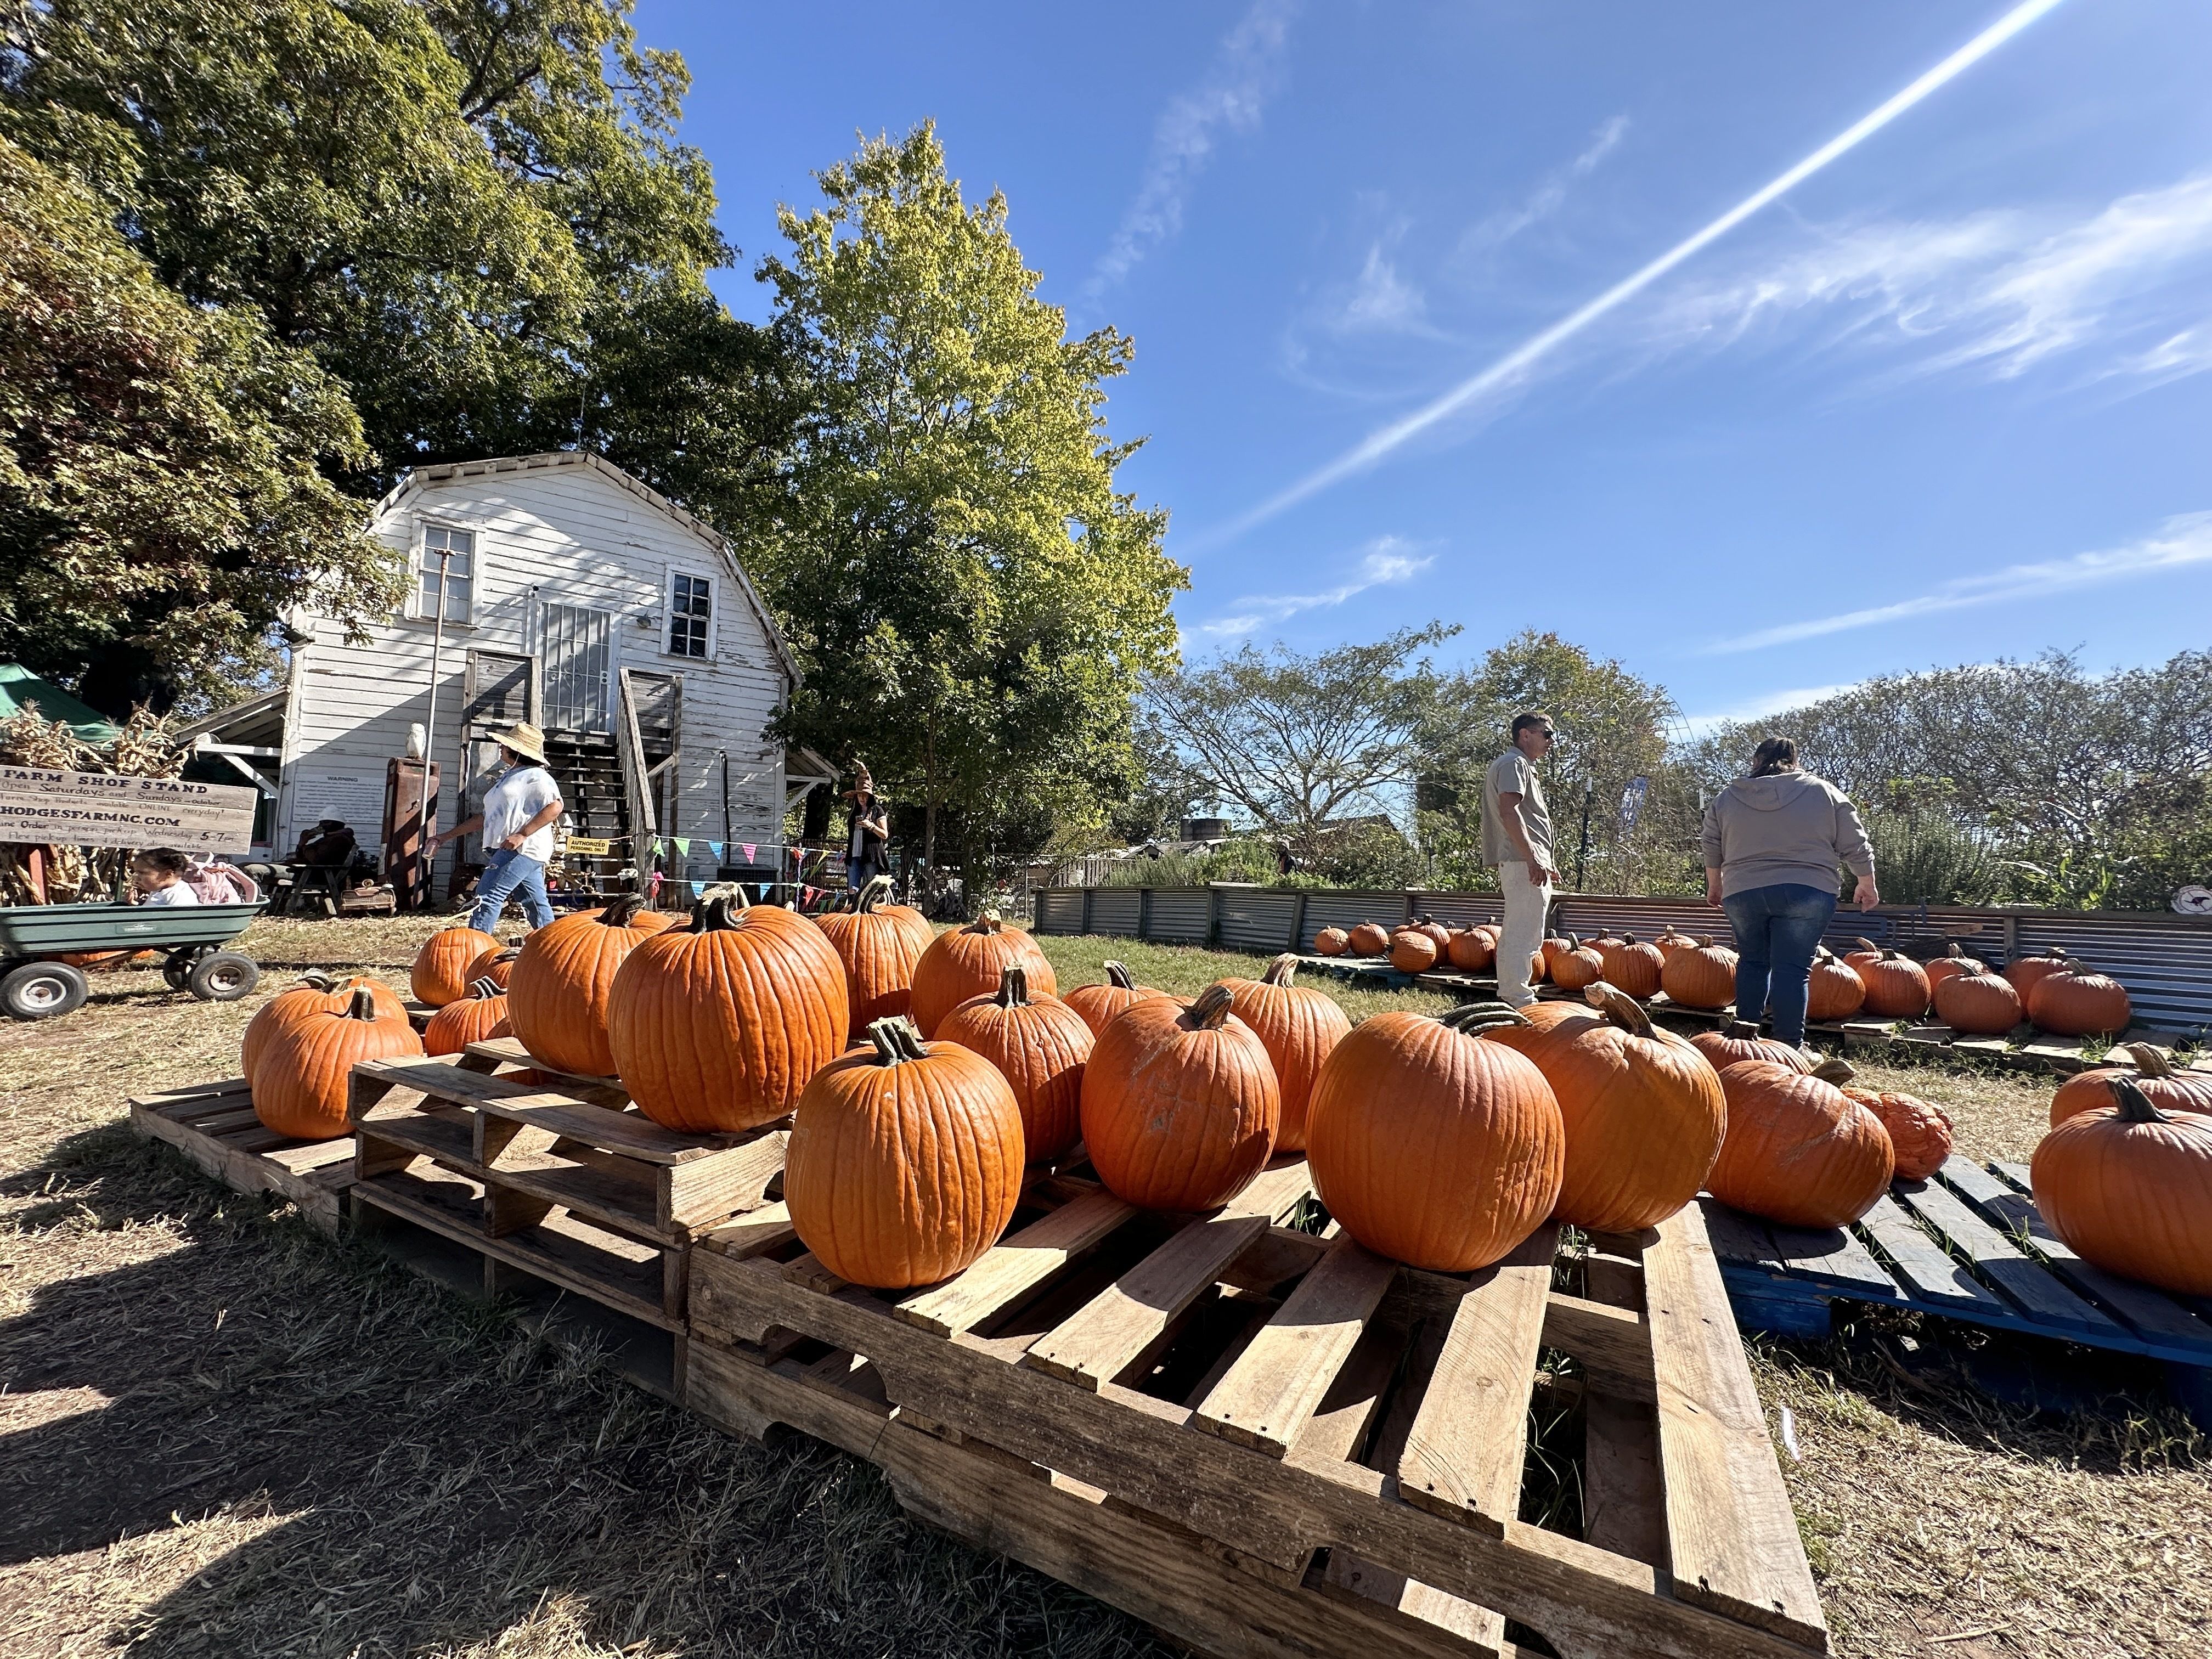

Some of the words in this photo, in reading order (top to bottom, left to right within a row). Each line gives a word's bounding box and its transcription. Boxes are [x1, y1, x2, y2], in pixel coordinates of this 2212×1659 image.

[2, 781, 30, 789] Open
[39, 783, 104, 797] Saturdays
[4, 770, 63, 782] FARM
[78, 776, 131, 788] SHOP
[141, 781, 207, 794] STAND
[1, 805, 180, 827] HODGESFARMNC.COM
[139, 803, 172, 812] ONLINE
[20, 820, 49, 829] Order
[144, 827, 193, 842] Wednesday
[110, 838, 144, 847] delivery
